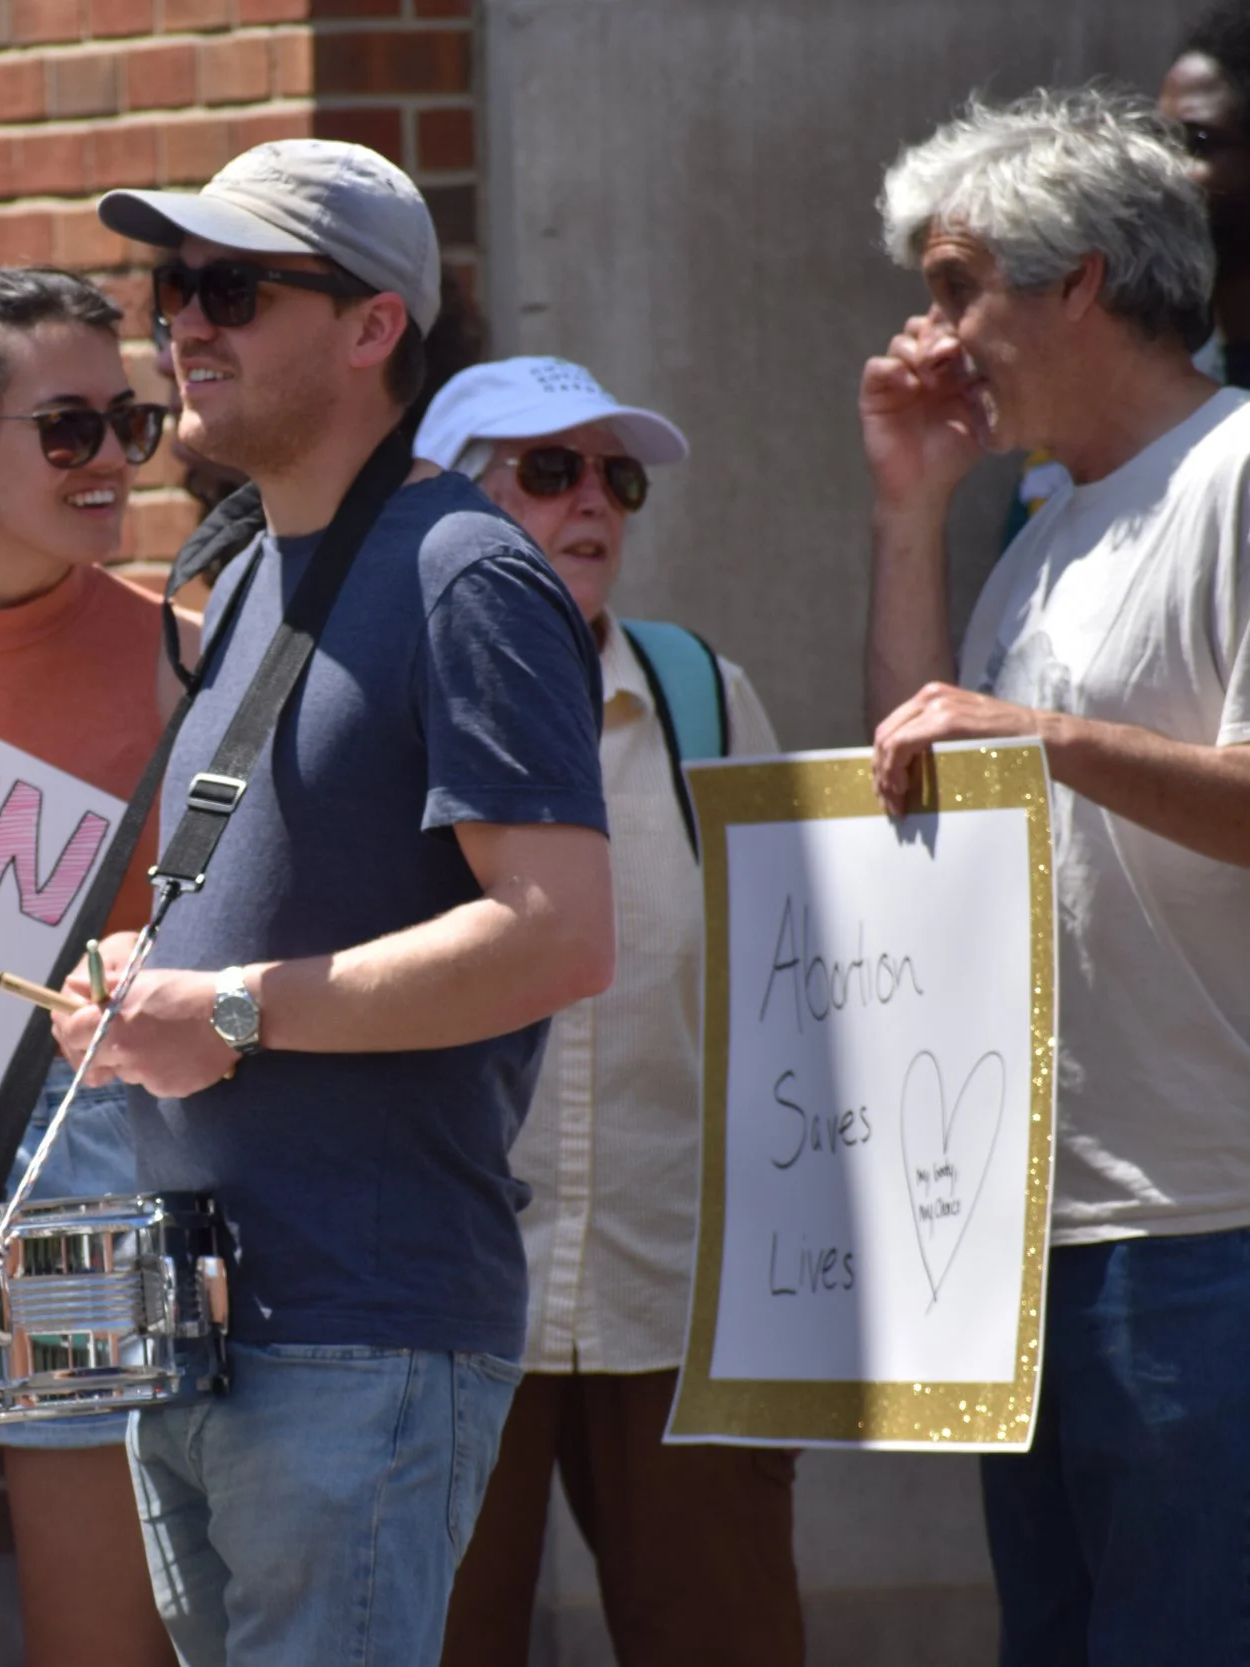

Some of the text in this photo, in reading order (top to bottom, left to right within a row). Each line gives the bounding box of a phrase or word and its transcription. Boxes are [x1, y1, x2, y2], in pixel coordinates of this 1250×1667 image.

[758, 892, 925, 1035] Abortion
[771, 1069, 872, 1170] Saves
[769, 1230, 855, 1297] Lives
